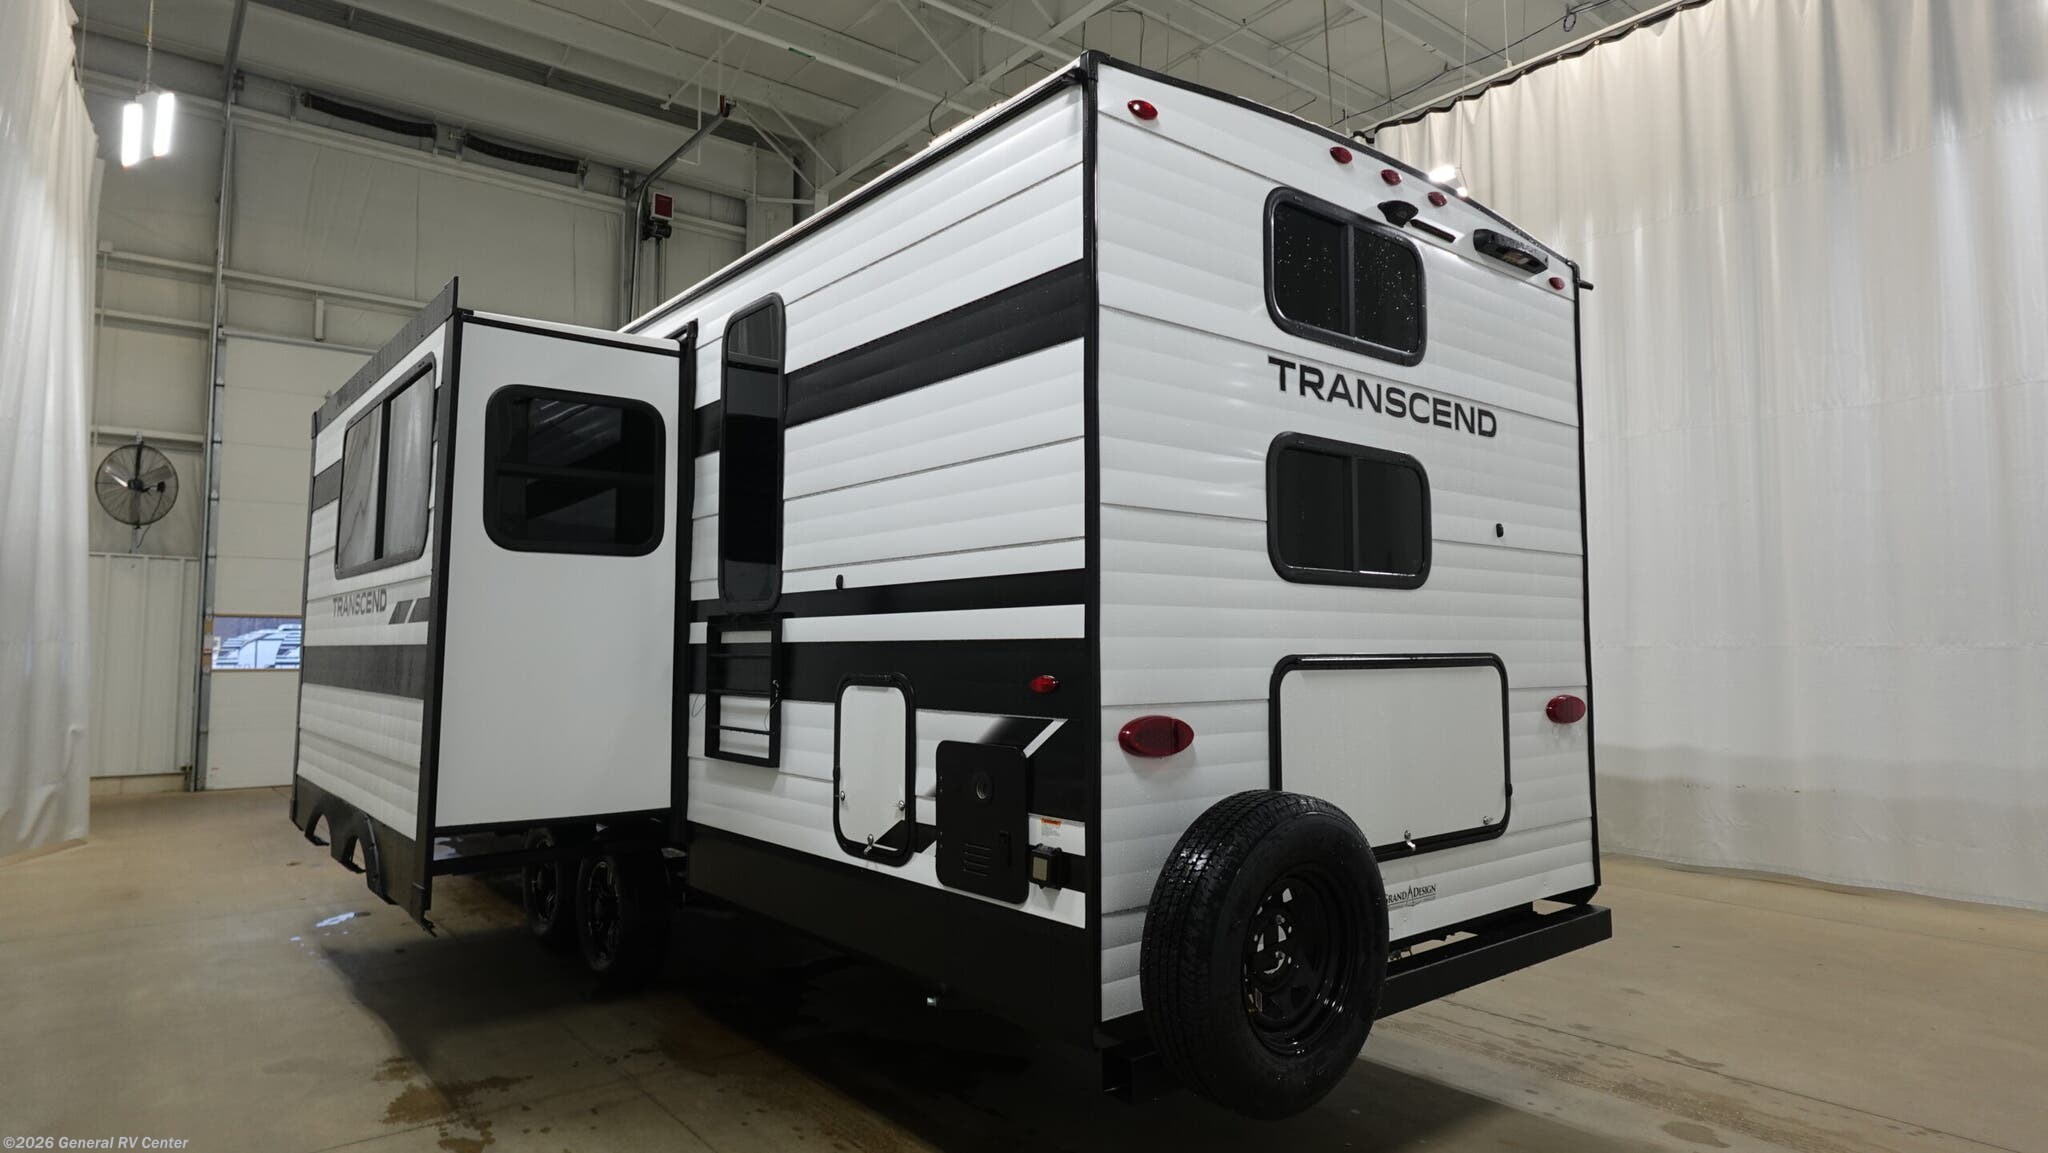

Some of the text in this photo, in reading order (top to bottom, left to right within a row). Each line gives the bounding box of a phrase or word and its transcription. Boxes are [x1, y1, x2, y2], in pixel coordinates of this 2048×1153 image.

[1267, 354, 1498, 439] TRANSCEND
[332, 587, 388, 618] TRANSCEND
[1413, 883, 1437, 898] DESIGN
